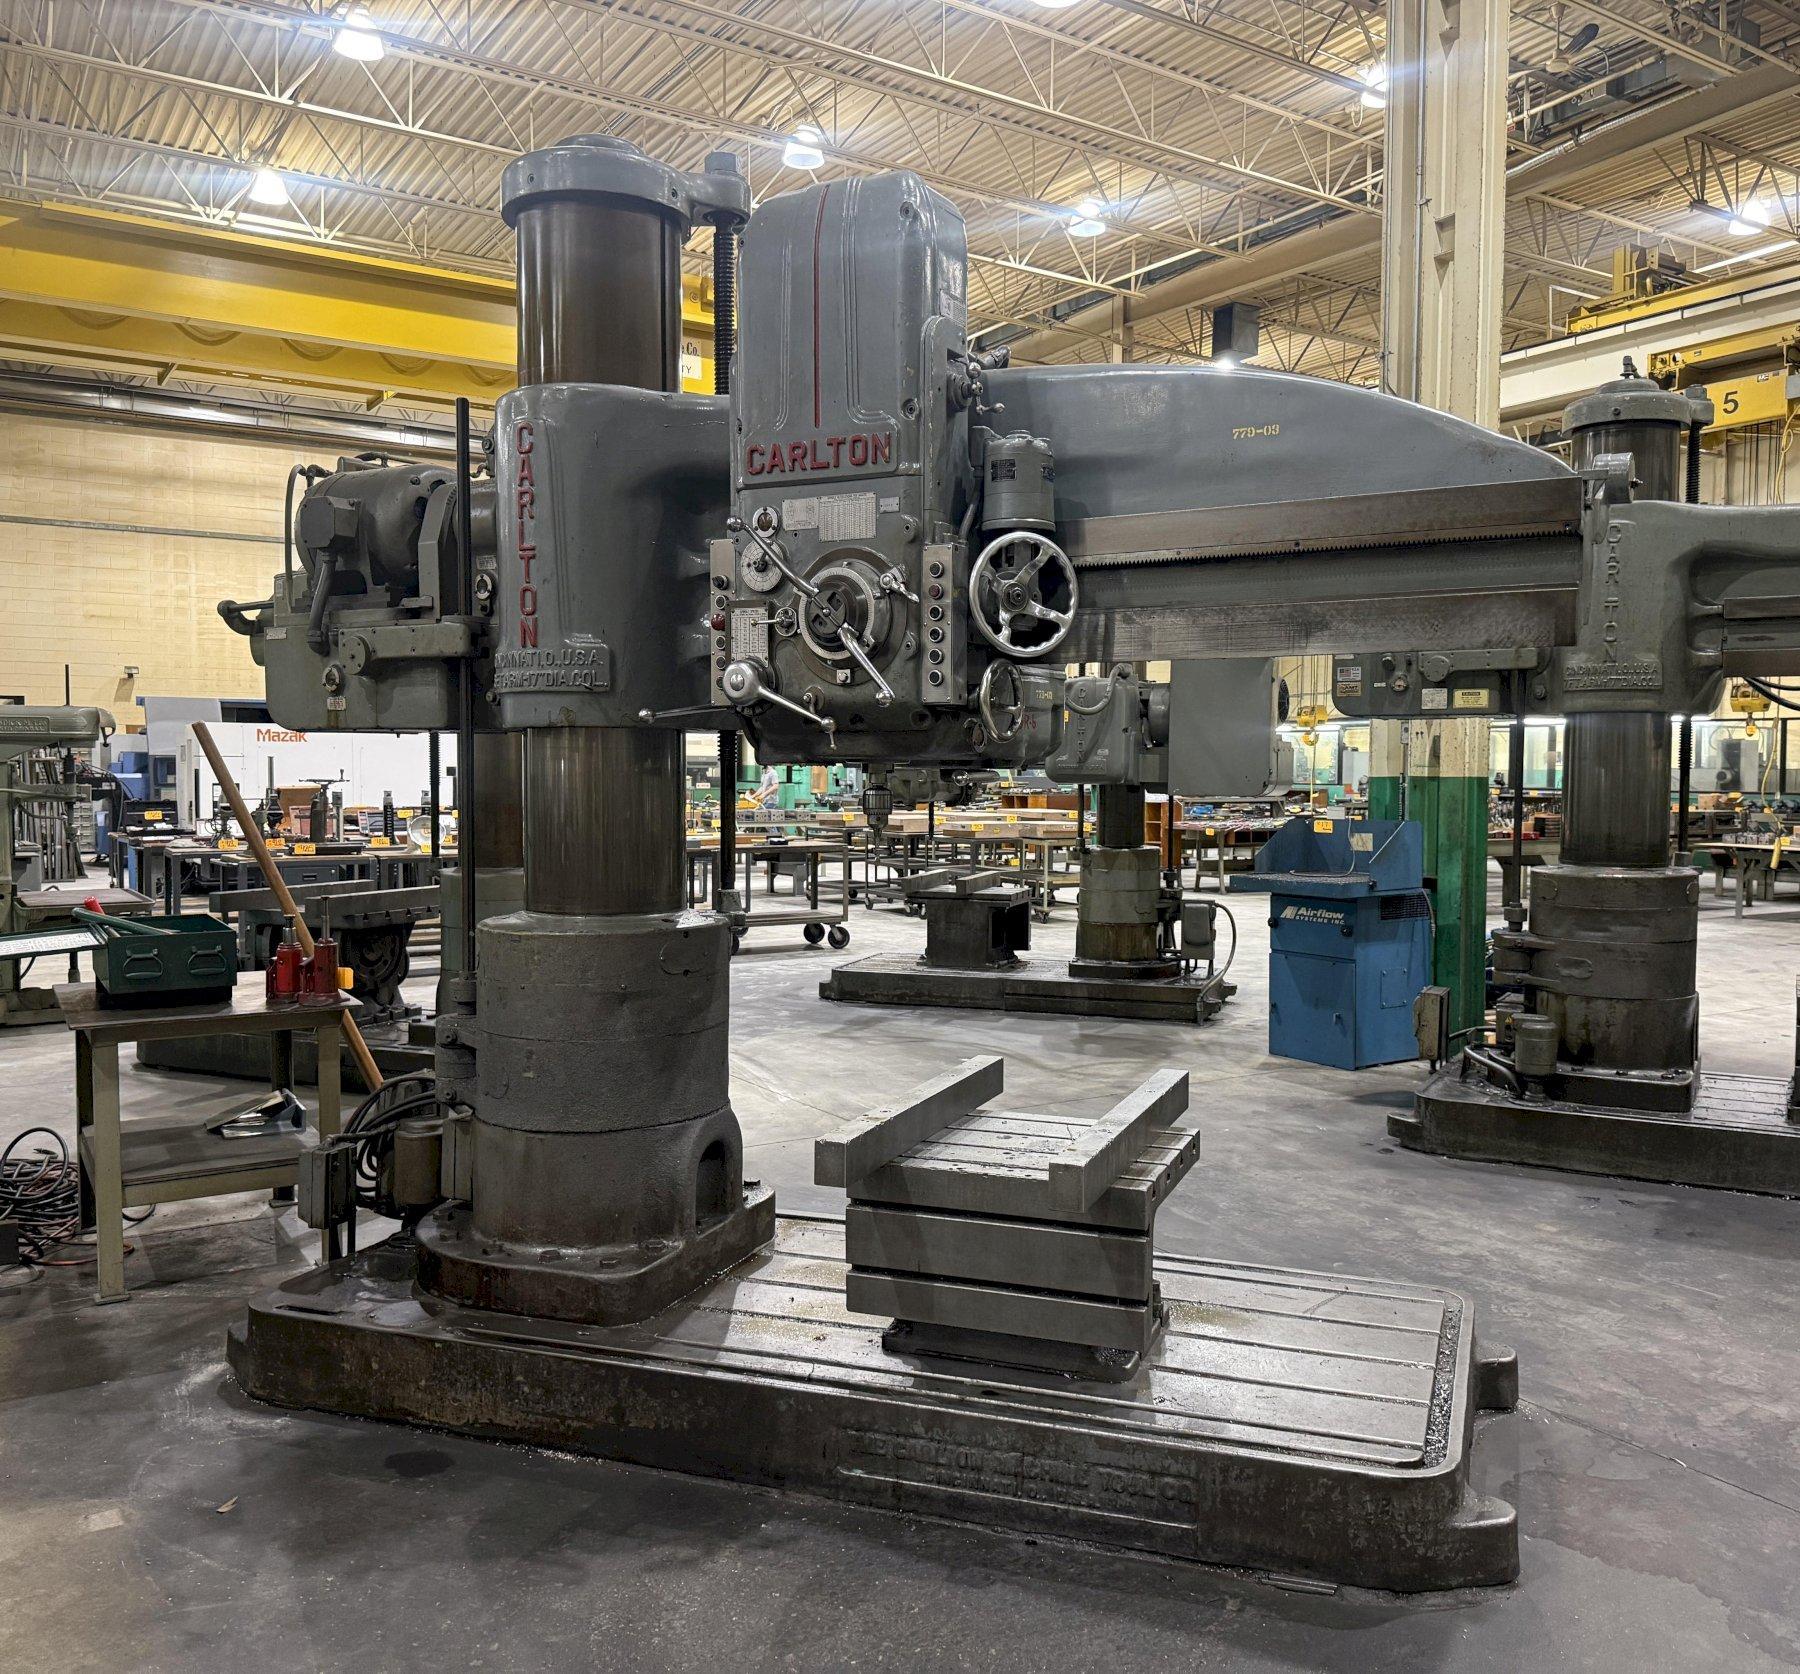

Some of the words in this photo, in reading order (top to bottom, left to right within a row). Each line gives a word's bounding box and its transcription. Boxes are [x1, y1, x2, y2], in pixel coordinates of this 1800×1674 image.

[1722, 390, 1739, 414] 5
[1232, 424, 1280, 440] 779-03
[747, 431, 892, 475] CARLTON
[516, 421, 537, 648] CARLTON
[256, 729, 308, 742] Mazak
[1295, 915, 1328, 924] SYSTEMS
[1297, 906, 1345, 919] Airflow
